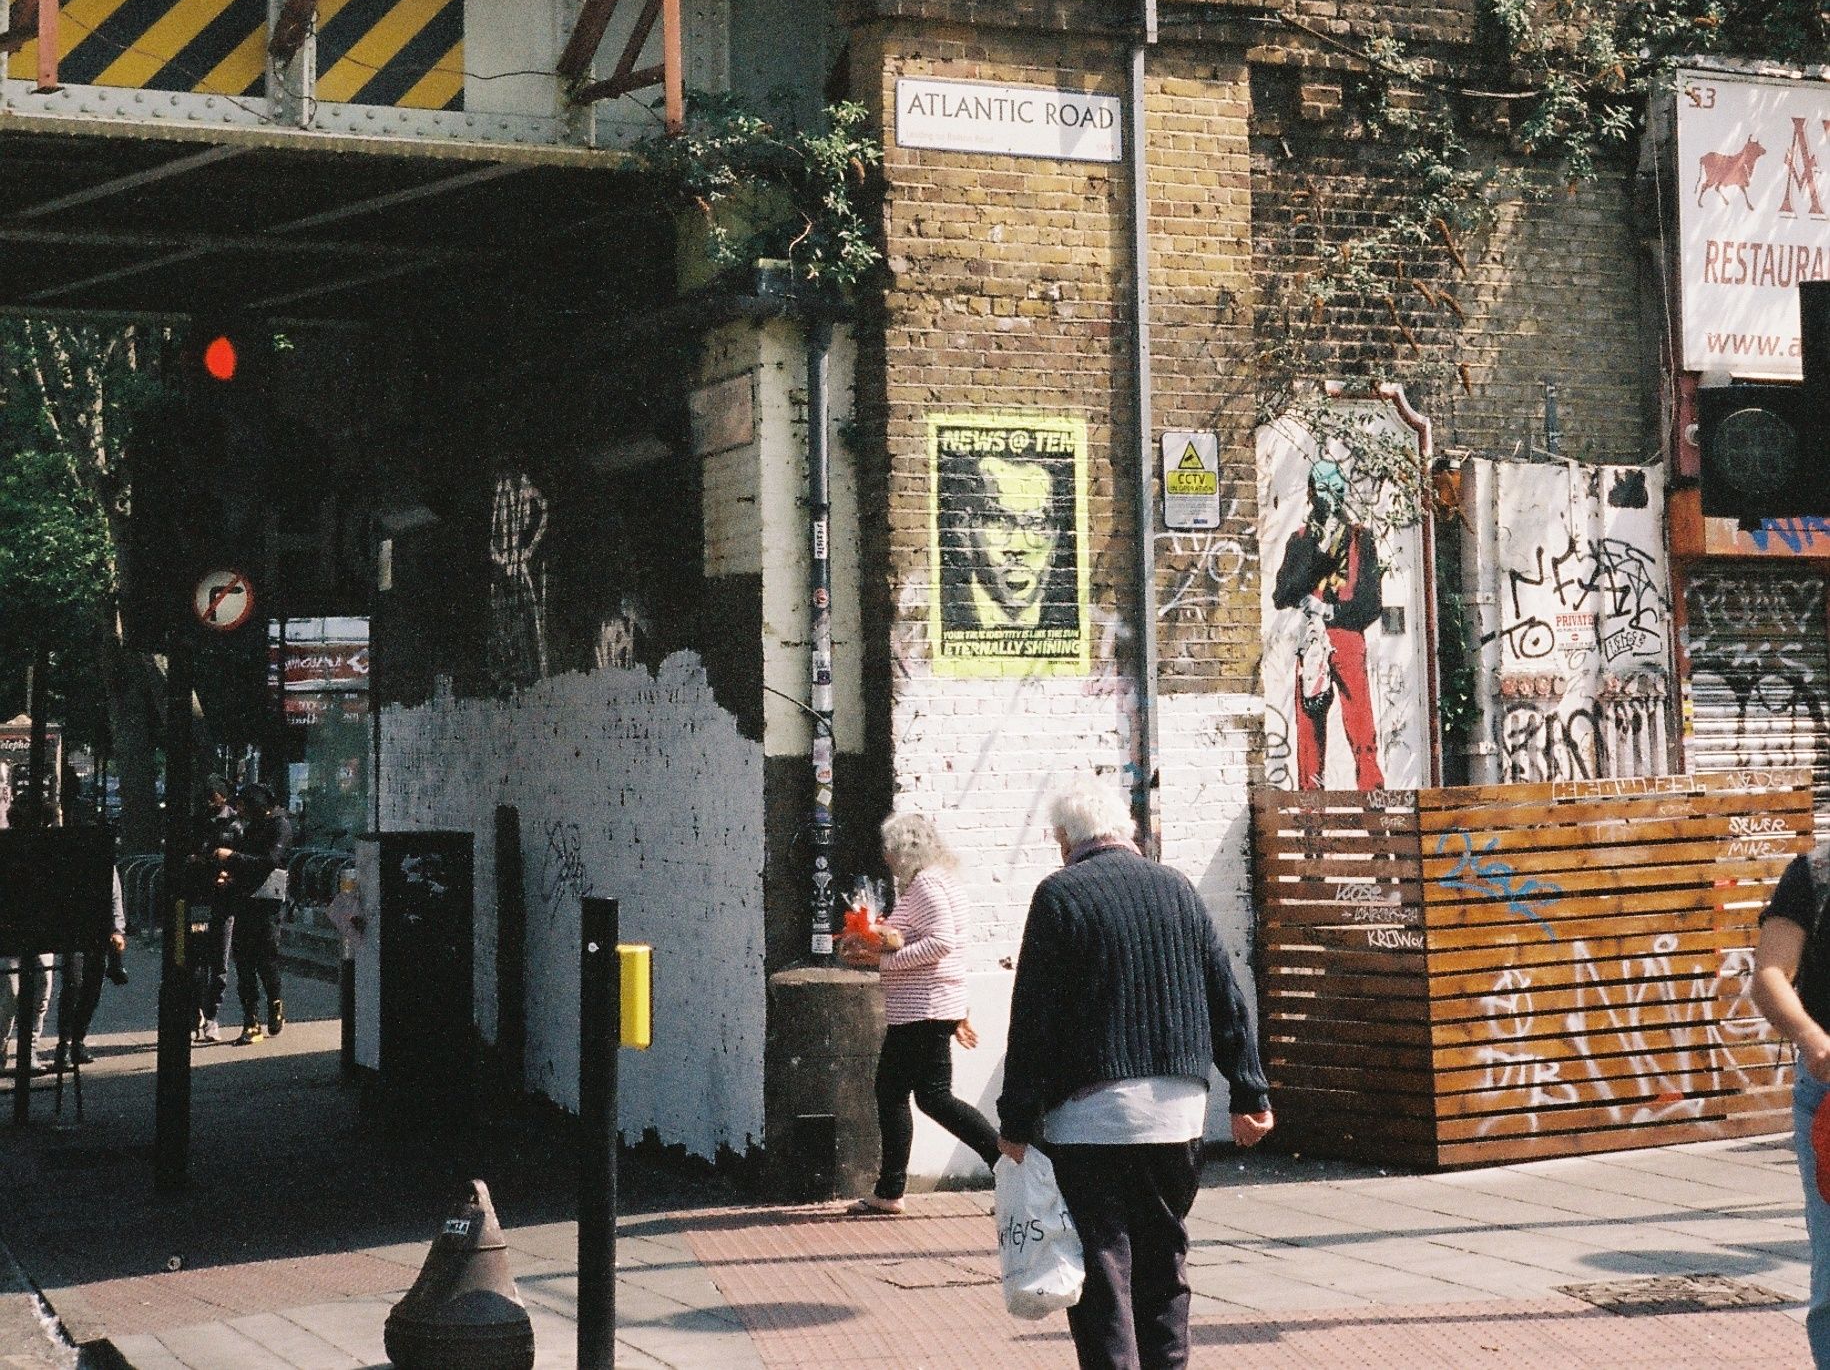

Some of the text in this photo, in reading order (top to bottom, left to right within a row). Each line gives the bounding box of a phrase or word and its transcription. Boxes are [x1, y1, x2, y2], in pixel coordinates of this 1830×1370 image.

[907, 91, 1115, 129] ATLANTIC ROAD
[1778, 116, 1830, 221] A
[1704, 239, 1830, 288] RESTAURA
[942, 429, 1007, 453] NEWS
[1035, 431, 1075, 454] TEN
[1177, 473, 1207, 485] CCTV
[1556, 613, 1595, 627] PRIVATE
[943, 640, 1080, 656] ETERNALLY SHINING
